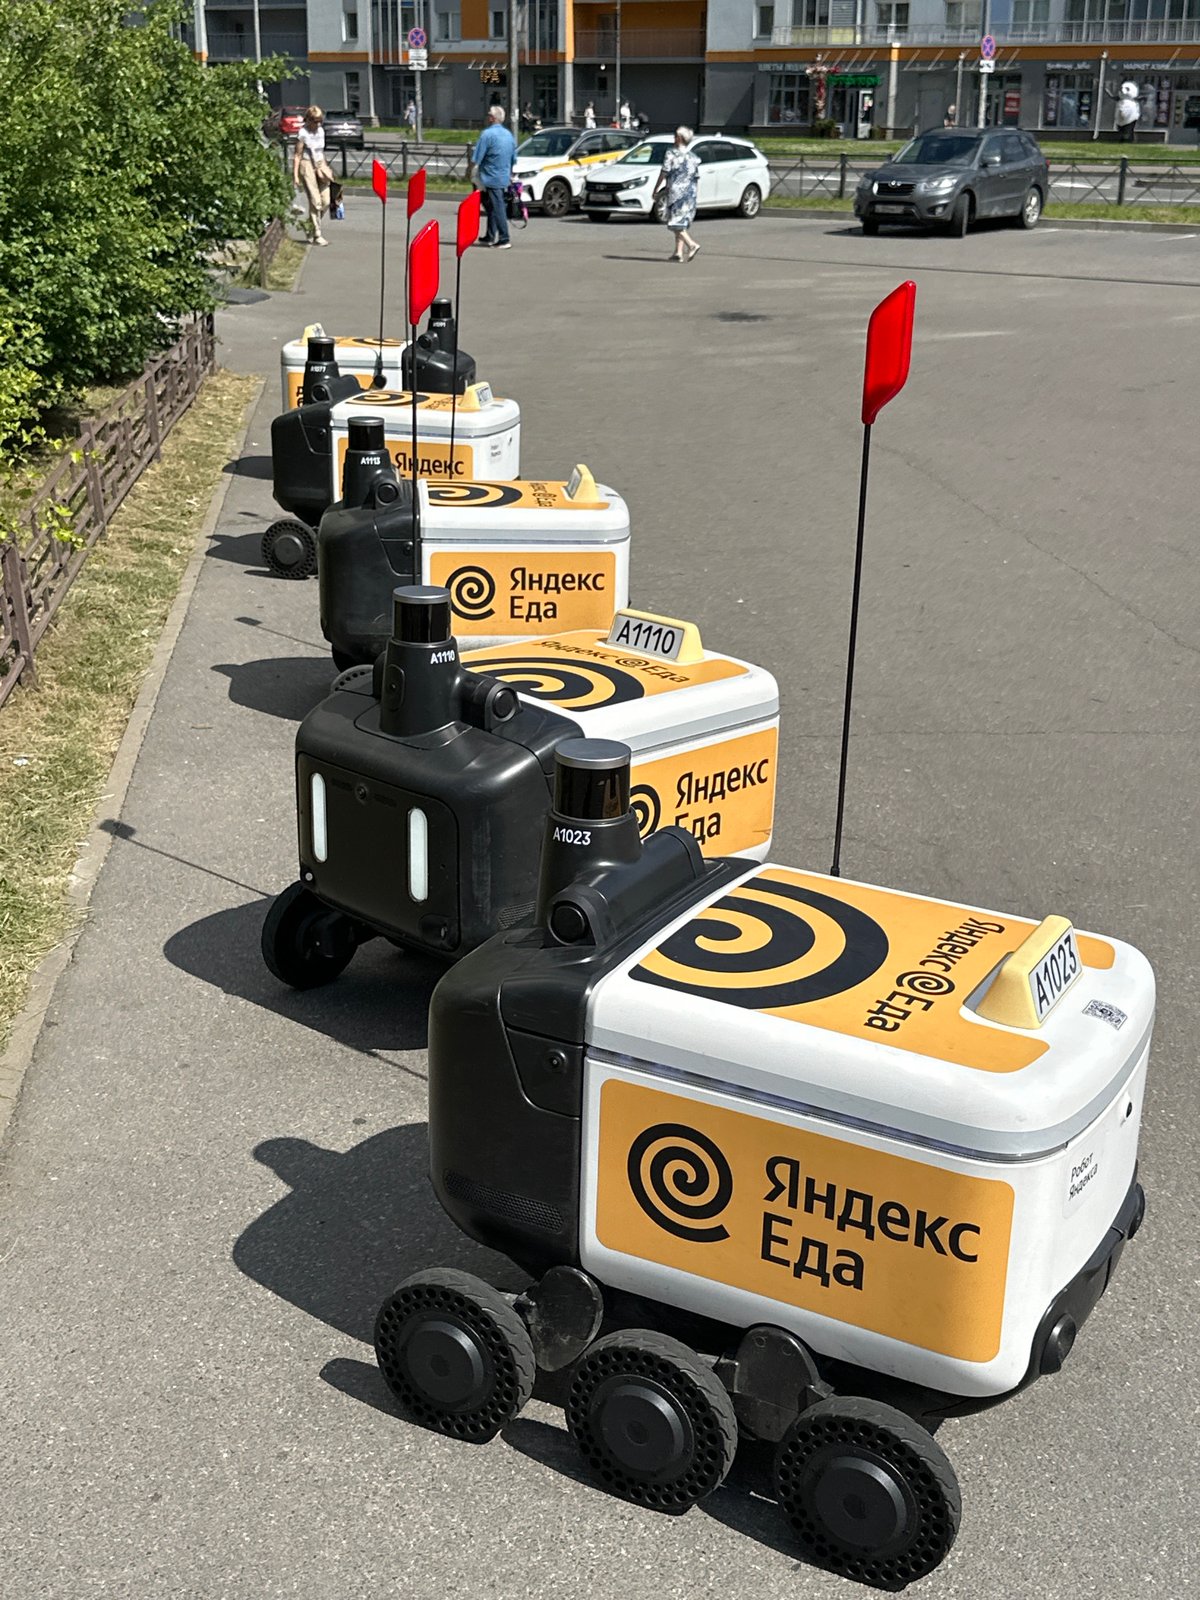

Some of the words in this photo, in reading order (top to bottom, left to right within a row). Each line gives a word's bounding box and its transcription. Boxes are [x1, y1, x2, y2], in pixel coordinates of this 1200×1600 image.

[395, 452, 464, 475] Яндекс
[509, 567, 605, 594] Яндекс
[510, 595, 557, 622] Еда
[616, 619, 676, 655] A1110
[430, 649, 456, 664] A1110
[641, 665, 690, 682] Еда
[675, 758, 769, 809] Яндекс
[553, 826, 591, 846] A1023
[919, 917, 1005, 972] Яндекс
[1035, 935, 1078, 1013] A1023
[863, 990, 934, 1032] Еда
[1068, 1163, 1098, 1200] Яндекса
[1071, 1152, 1093, 1182] Робот
[763, 1155, 981, 1263] Яндекс
[760, 1211, 865, 1290] Еда
